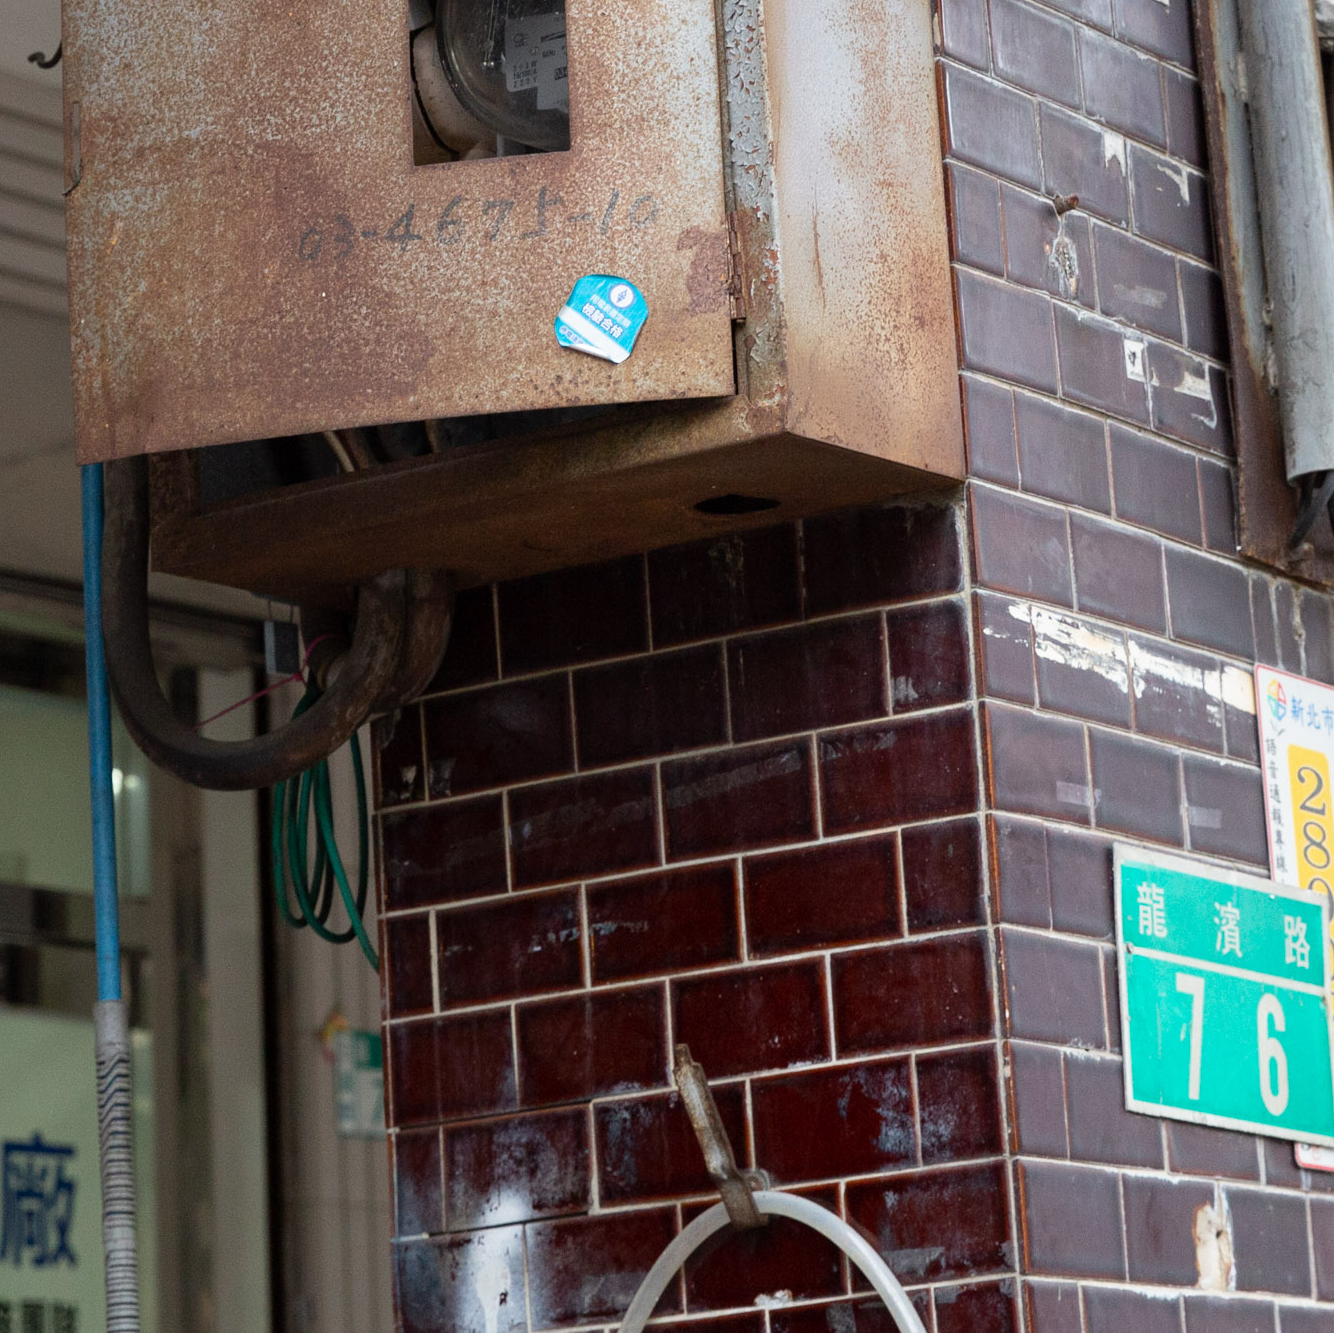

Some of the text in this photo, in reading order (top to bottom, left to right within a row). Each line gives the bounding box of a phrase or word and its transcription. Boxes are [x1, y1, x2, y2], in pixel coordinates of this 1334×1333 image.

[1290, 695, 1334, 737] 新北市
[1136, 880, 1311, 970] 龍濱路
[1174, 972, 1290, 1117] 76
